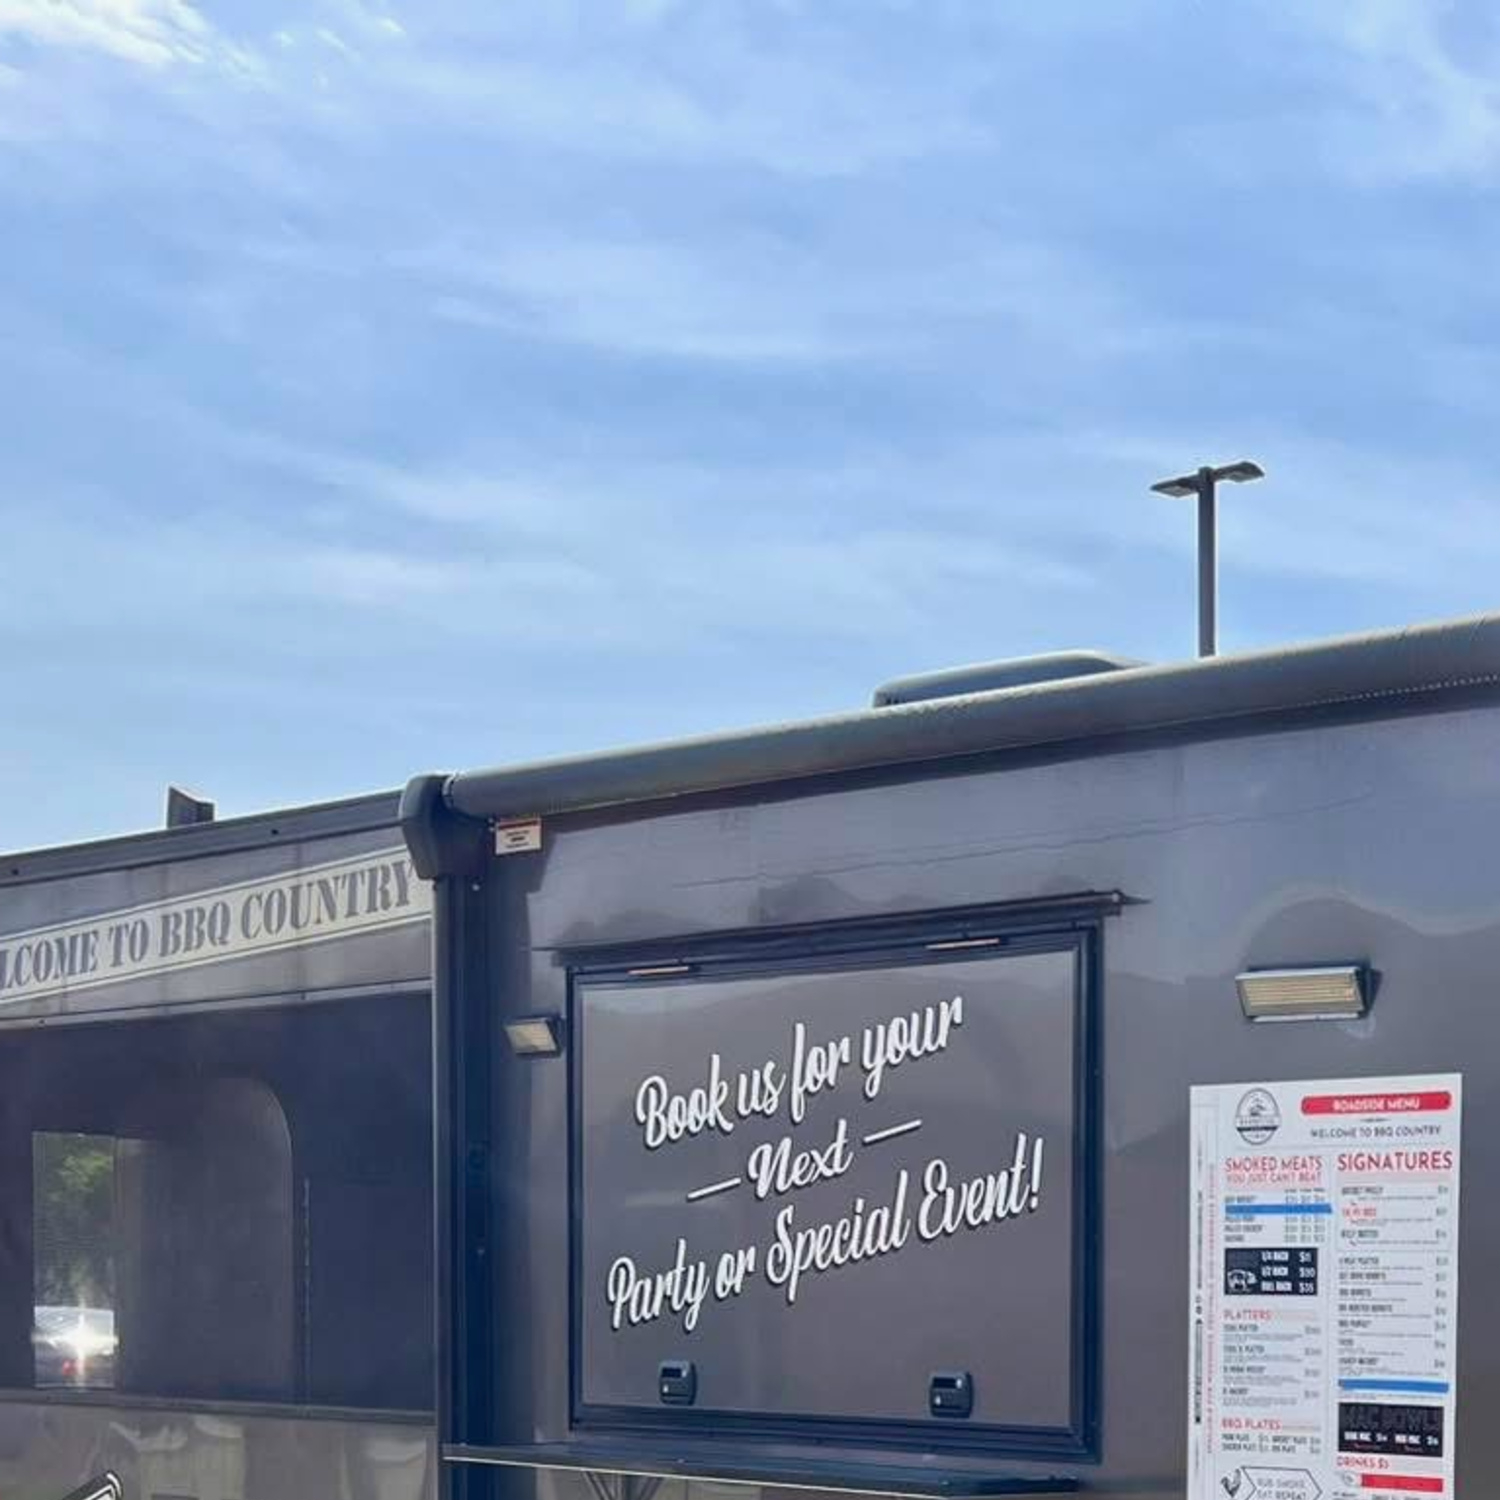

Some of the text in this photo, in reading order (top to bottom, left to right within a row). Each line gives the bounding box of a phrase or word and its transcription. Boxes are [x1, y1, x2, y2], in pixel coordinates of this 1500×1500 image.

[108, 918, 150, 967] TO
[159, 901, 231, 957] BBQ
[240, 859, 412, 940] COUNTRY
[635, 996, 963, 1149] Book us for your
[1387, 1097, 1420, 1110] MENU
[1310, 1125, 1442, 1138] WELCOME TO BBQ COUNTRY
[748, 1118, 854, 1199] Next
[1224, 1155, 1322, 1172] SMOKED MEATS
[1337, 1151, 1453, 1171] SIGNATURES
[608, 1132, 1044, 1331] Party or Special Event!
